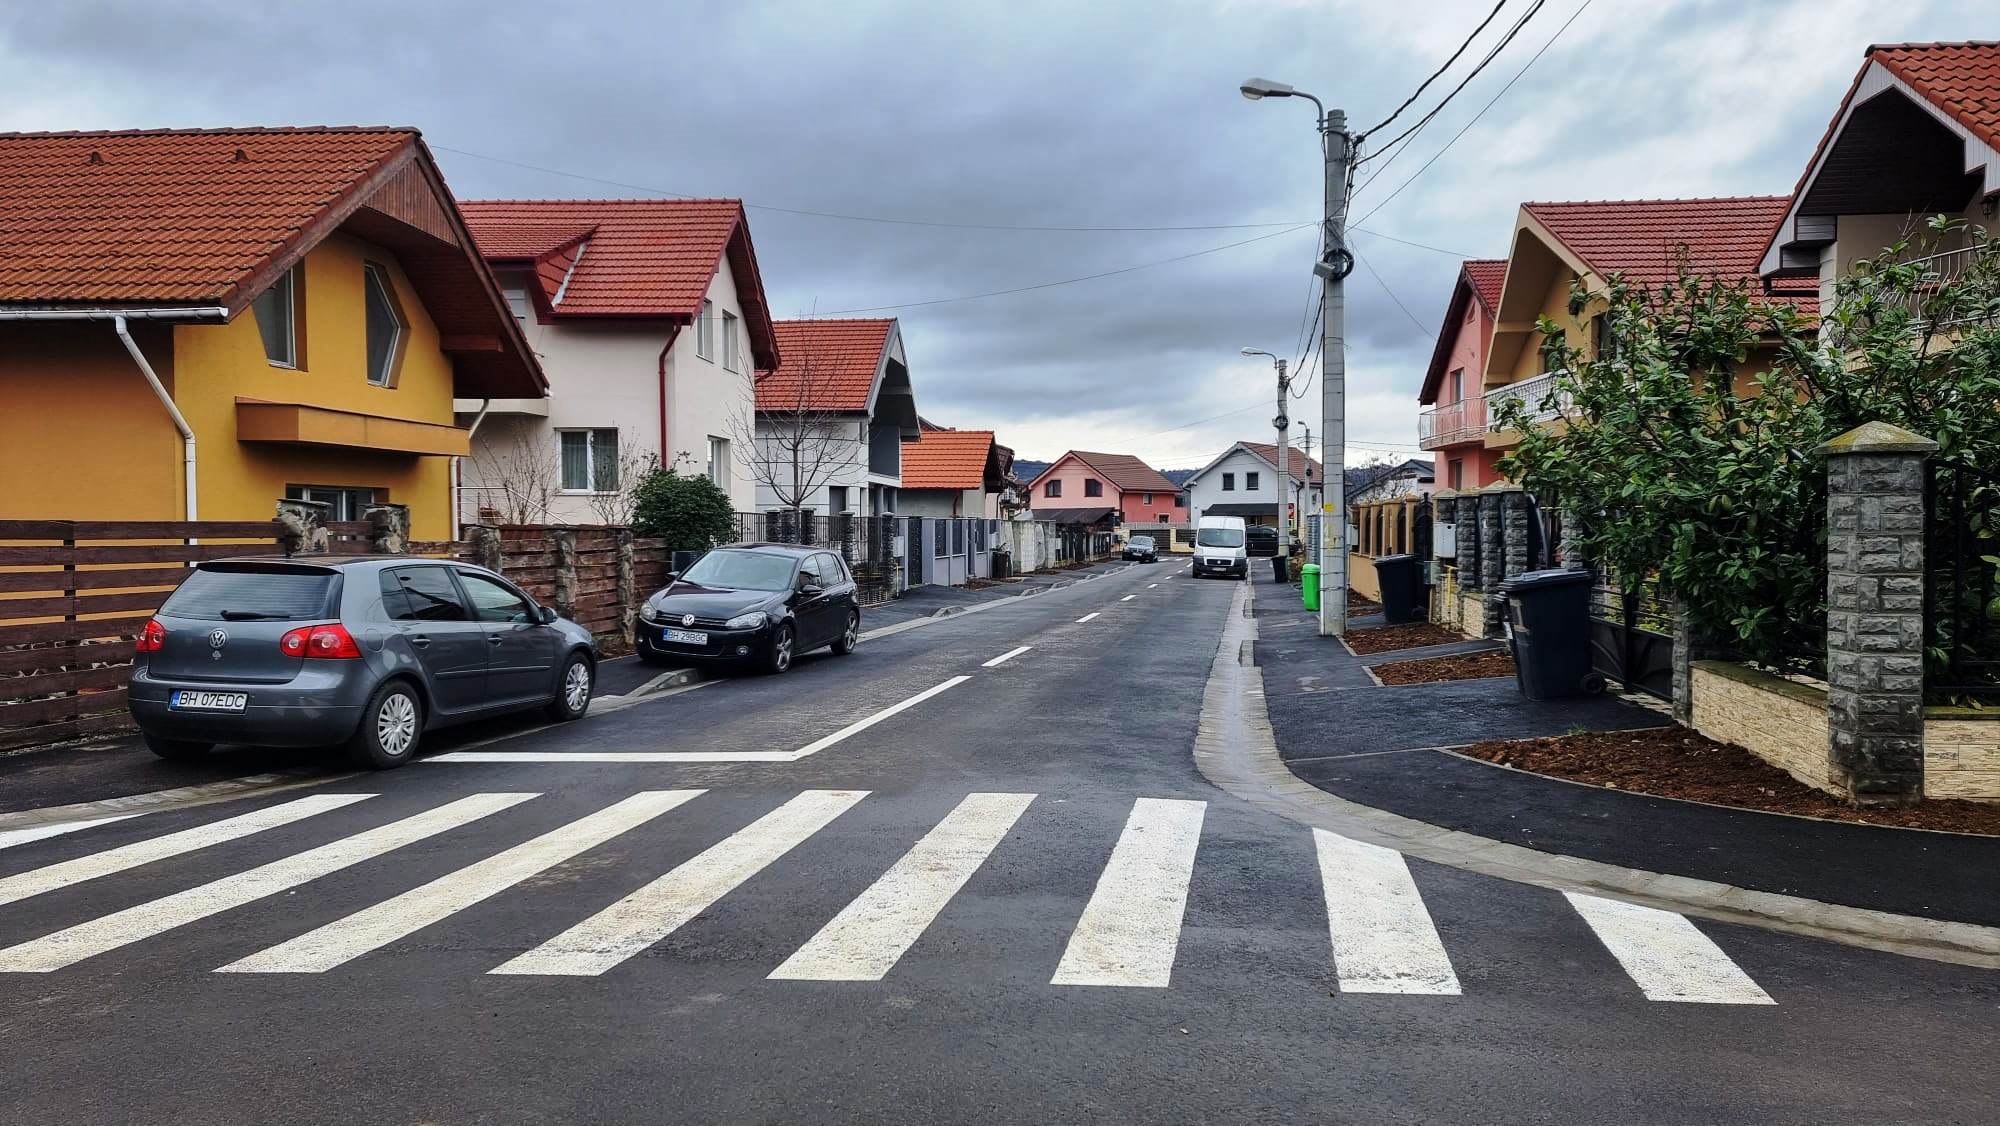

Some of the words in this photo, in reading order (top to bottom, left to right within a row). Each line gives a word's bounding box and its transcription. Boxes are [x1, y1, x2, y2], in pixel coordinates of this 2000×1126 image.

[668, 630, 679, 639] BH
[179, 692, 198, 705] BH
[201, 693, 245, 708] 07EDC
